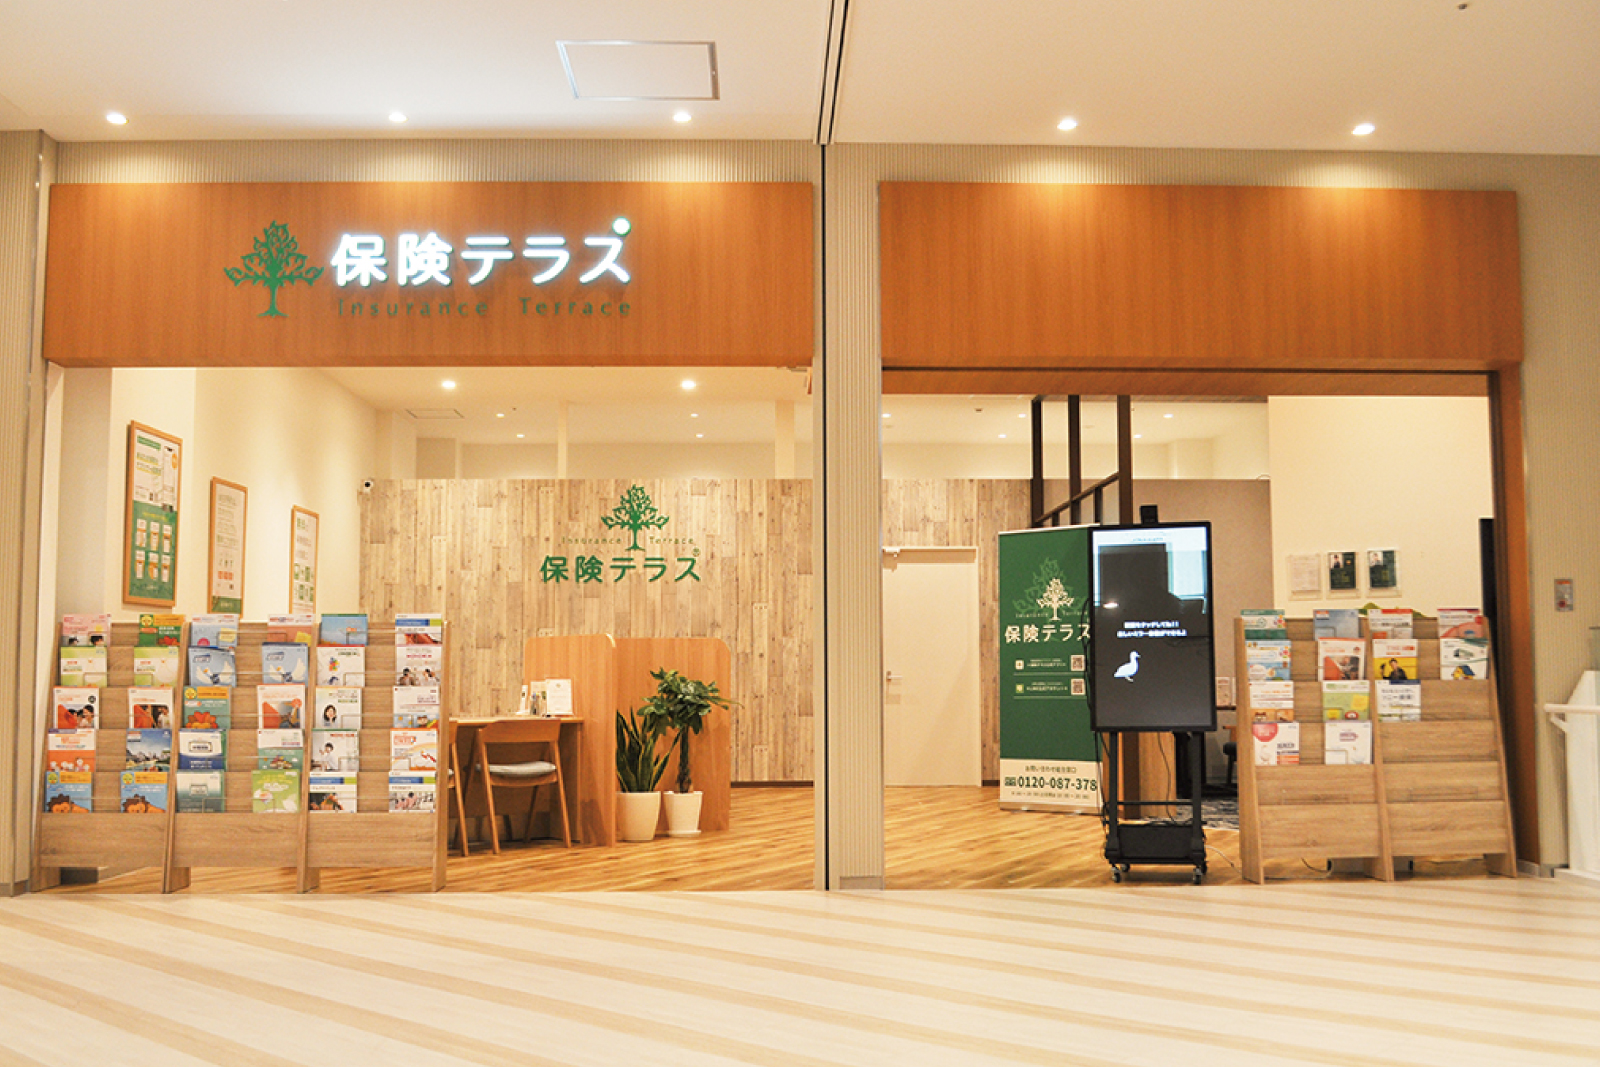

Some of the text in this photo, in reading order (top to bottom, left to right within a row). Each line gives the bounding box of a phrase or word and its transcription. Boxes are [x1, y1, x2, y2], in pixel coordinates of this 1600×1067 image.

[331, 231, 632, 287] 保険テラス
[338, 297, 631, 315] Insurance Terrace
[562, 536, 694, 545] Insurance Terrace
[540, 554, 701, 583] 保険テラス
[1004, 623, 1091, 644] 保険テラス
[1017, 775, 1098, 792] 0120-087-378
